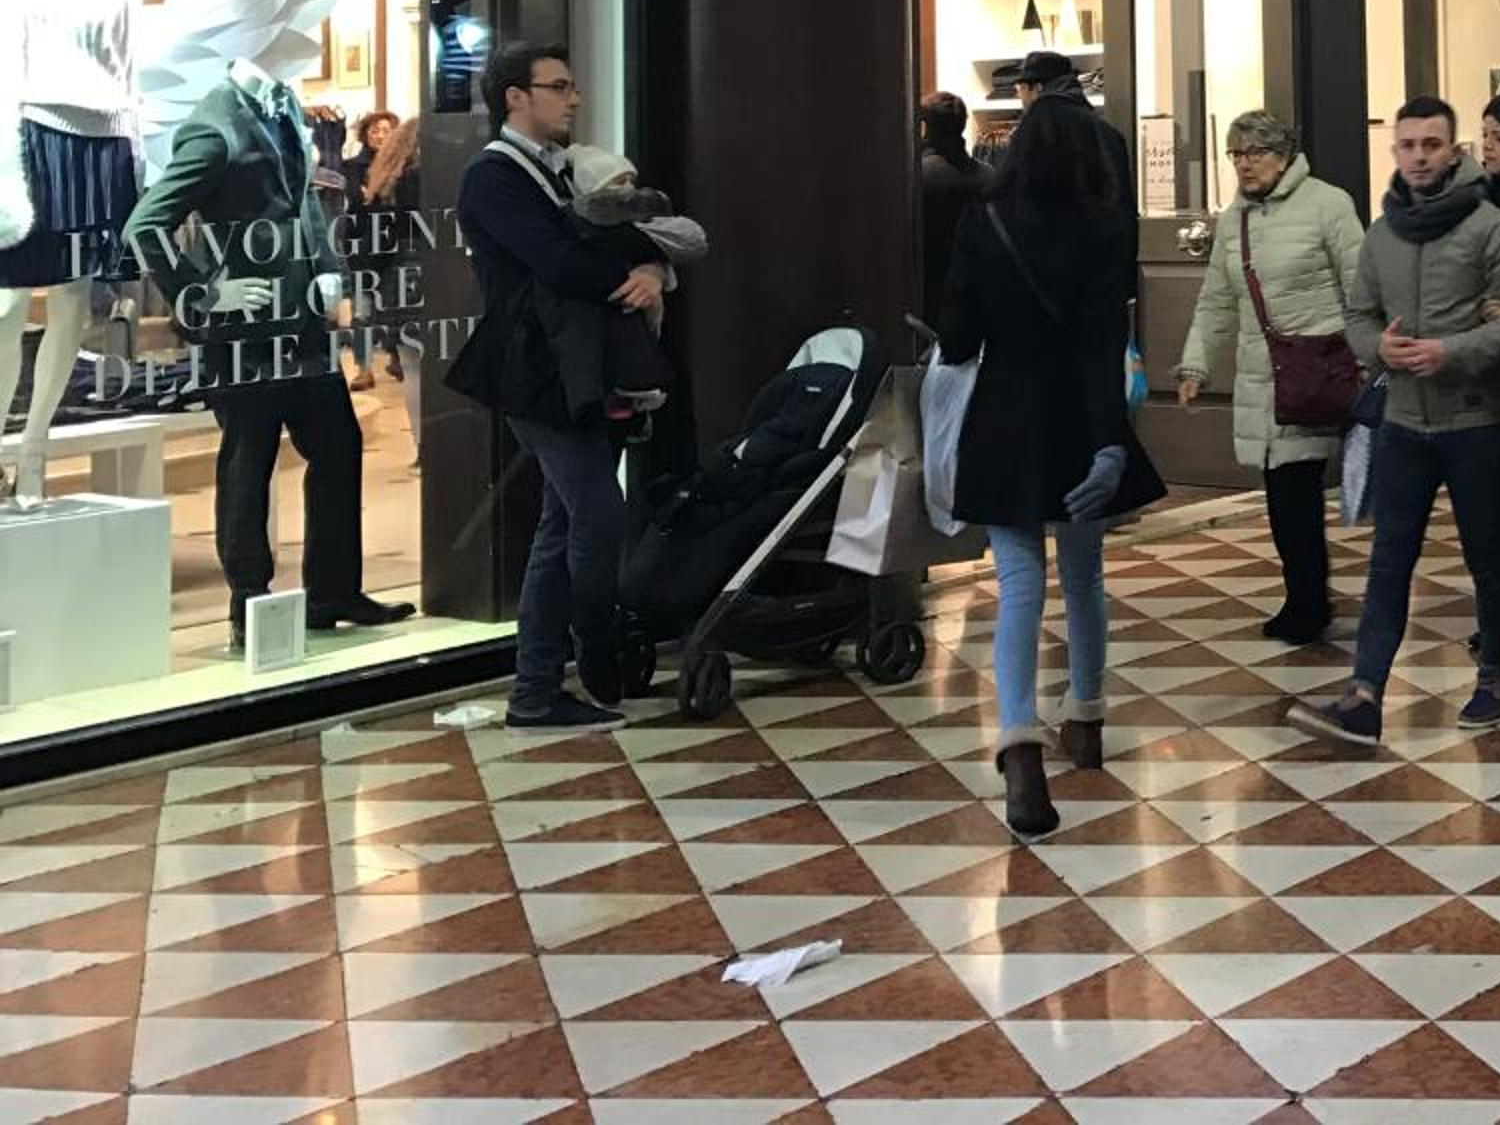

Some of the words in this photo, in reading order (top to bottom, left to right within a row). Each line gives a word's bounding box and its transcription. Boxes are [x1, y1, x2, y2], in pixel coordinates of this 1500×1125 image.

[66, 208, 464, 280] L'AVVOLGENT
[94, 334, 304, 403] DELLE
[327, 315, 483, 374] FEST
